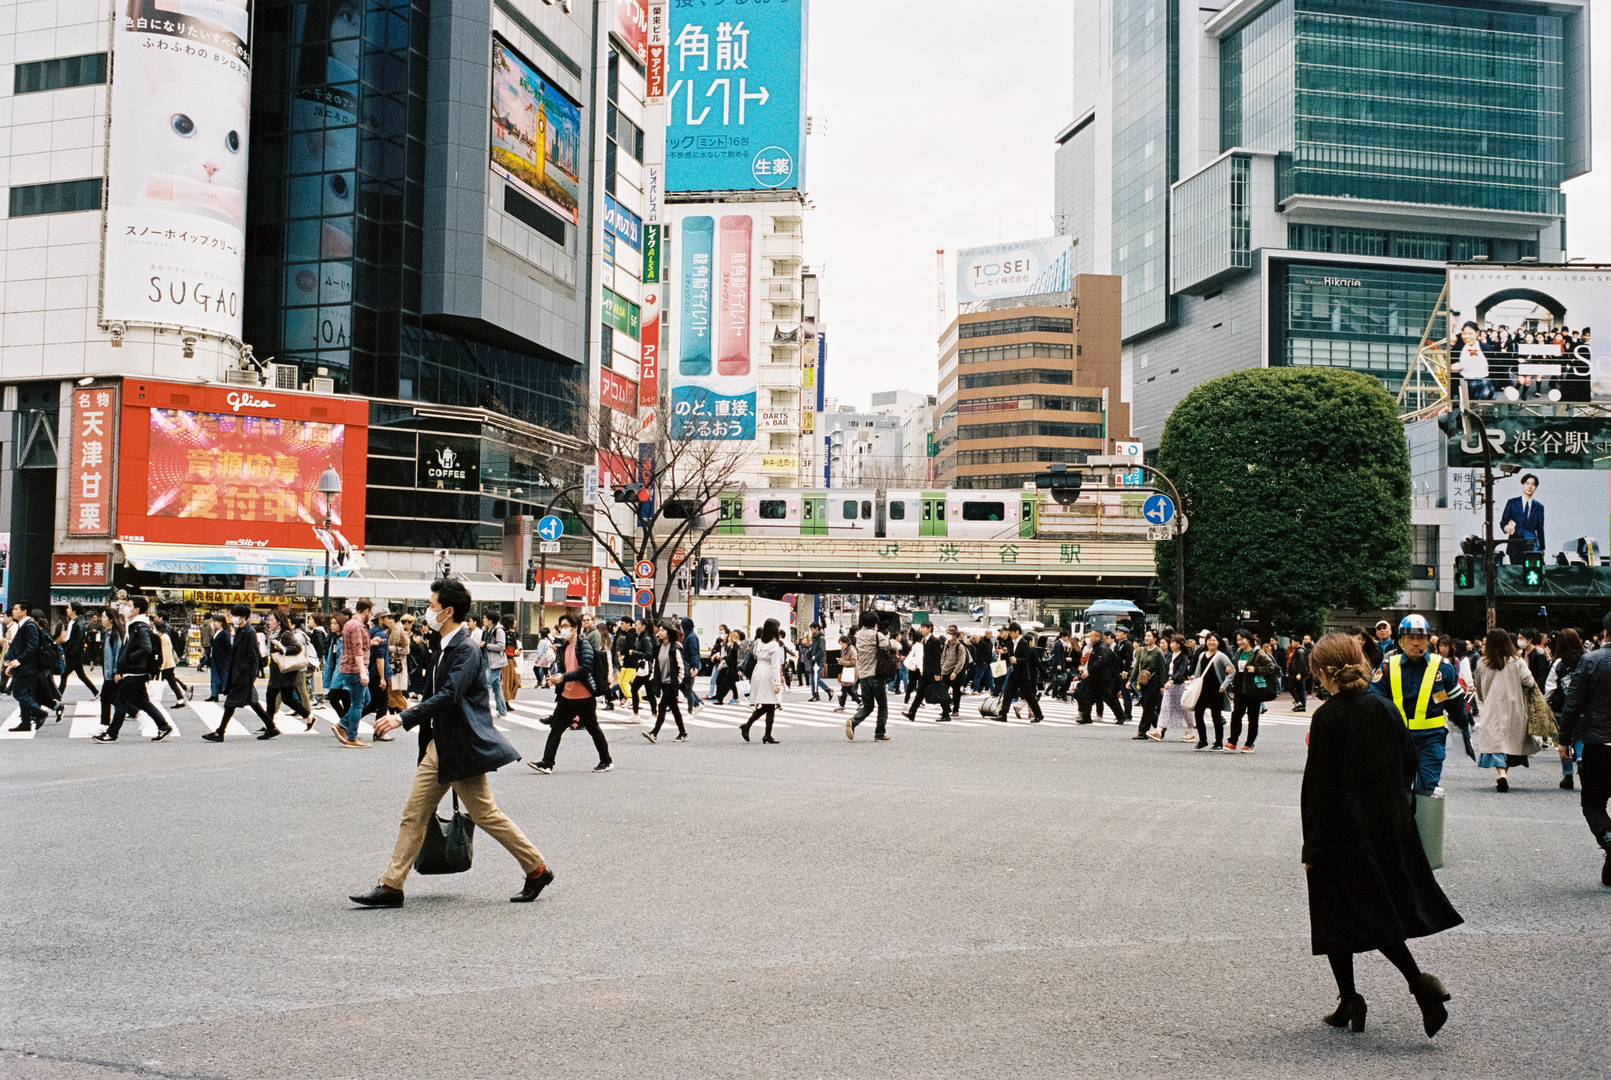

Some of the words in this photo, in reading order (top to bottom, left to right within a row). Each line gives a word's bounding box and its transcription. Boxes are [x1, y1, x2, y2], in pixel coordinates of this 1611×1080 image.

[617, 0, 647, 33] イフル
[143, 38, 208, 59] ふわふわの
[667, 21, 750, 72] 角散
[650, 58, 661, 95] アイフル
[699, 137, 725, 147] ミント
[755, 158, 789, 175] 生薬
[126, 226, 238, 255] スノーホイップクリーム
[975, 275, 1029, 288] トーセイ株式会社
[1324, 277, 1361, 287] Hikarie
[643, 345, 655, 378] アコム
[602, 378, 625, 402] アコム
[78, 393, 110, 408] 名物
[227, 391, 276, 411] Glico
[675, 400, 754, 416] のど、直接、
[683, 420, 742, 436] うるおう
[1513, 430, 1590, 454] 渋谷駅
[80, 411, 104, 529] 天津甘栗
[186, 449, 300, 481] 音源応募
[428, 468, 466, 479] COFFEE
[878, 544, 899, 556] JR
[56, 562, 105, 576] 天津甘栗
[195, 591, 224, 602] 免税店
